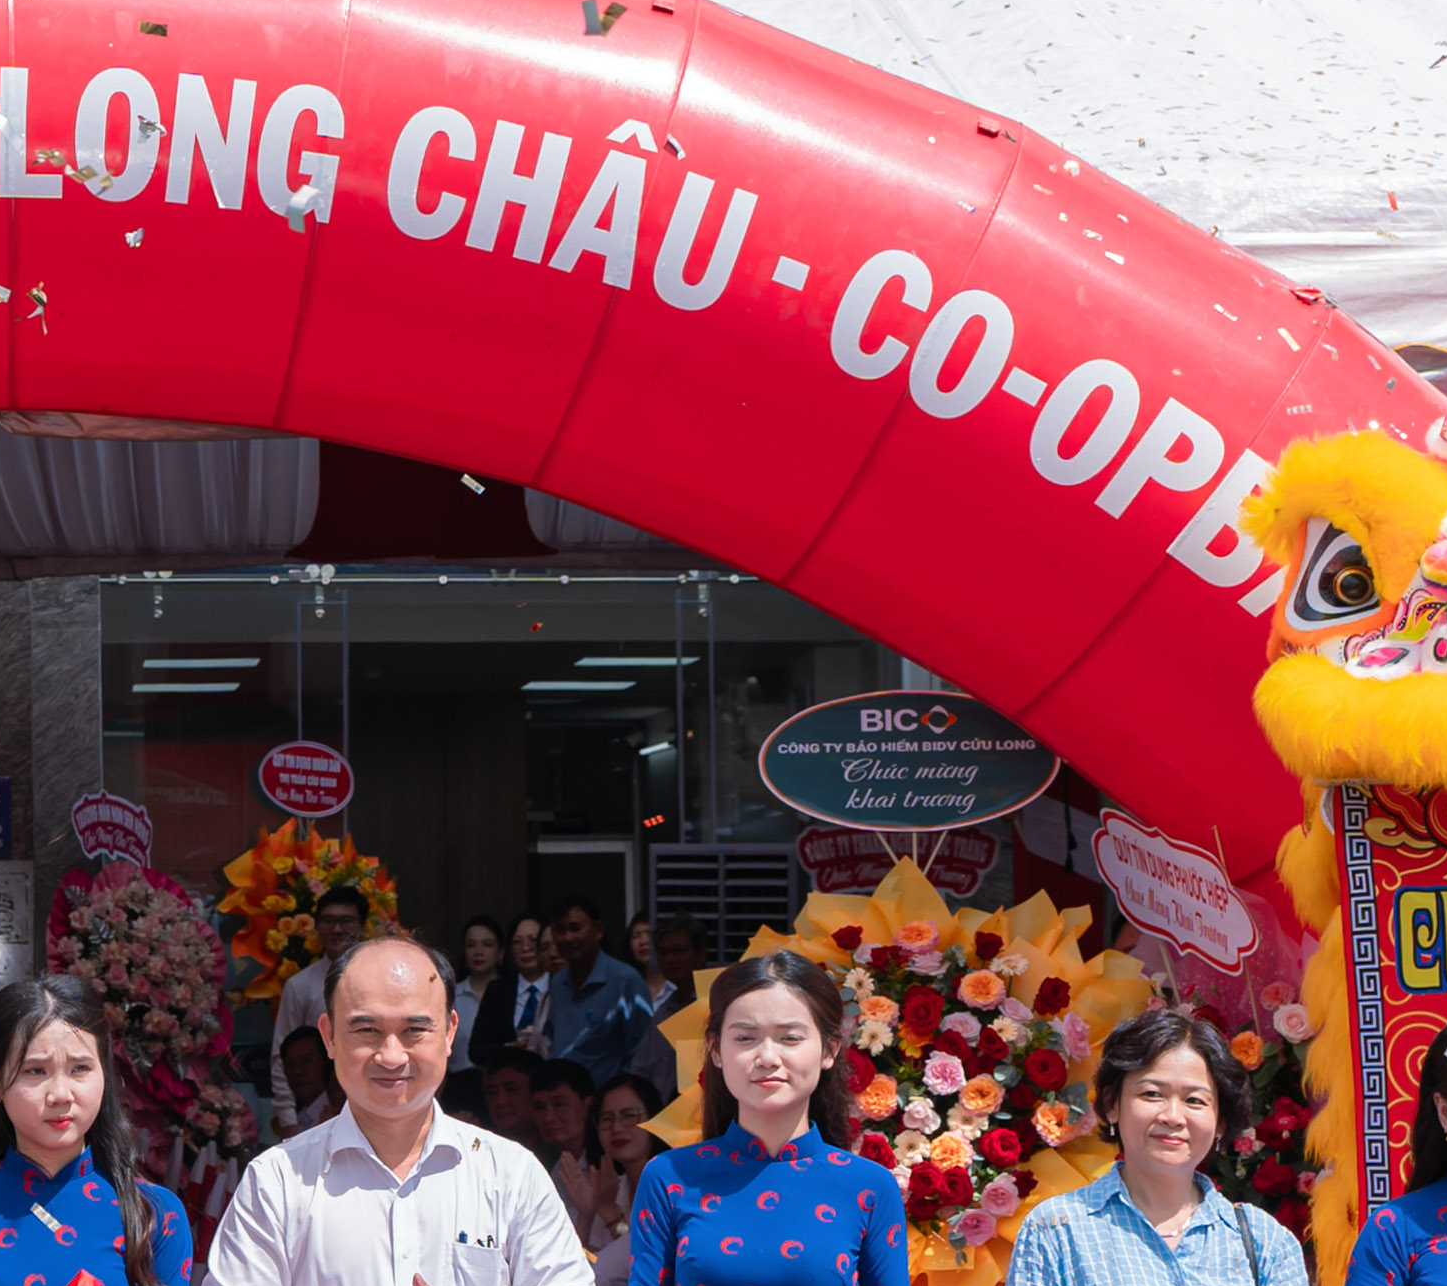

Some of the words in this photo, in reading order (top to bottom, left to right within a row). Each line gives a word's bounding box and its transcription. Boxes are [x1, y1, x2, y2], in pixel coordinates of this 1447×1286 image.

[386, 106, 759, 311] CHÂU
[771, 254, 810, 291] -
[829, 249, 1284, 618] CO-OPB
[859, 708, 919, 733] BIC
[777, 740, 821, 755] CÔNG
[823, 741, 843, 754] TY
[846, 738, 878, 754] BẢO
[922, 740, 958, 753] BIDV
[960, 735, 993, 752] CỬU
[995, 738, 1037, 751] LONG
[840, 758, 910, 783] Chúc
[913, 763, 980, 787] mừng
[844, 787, 898, 811] khai
[902, 789, 977, 814] trương
